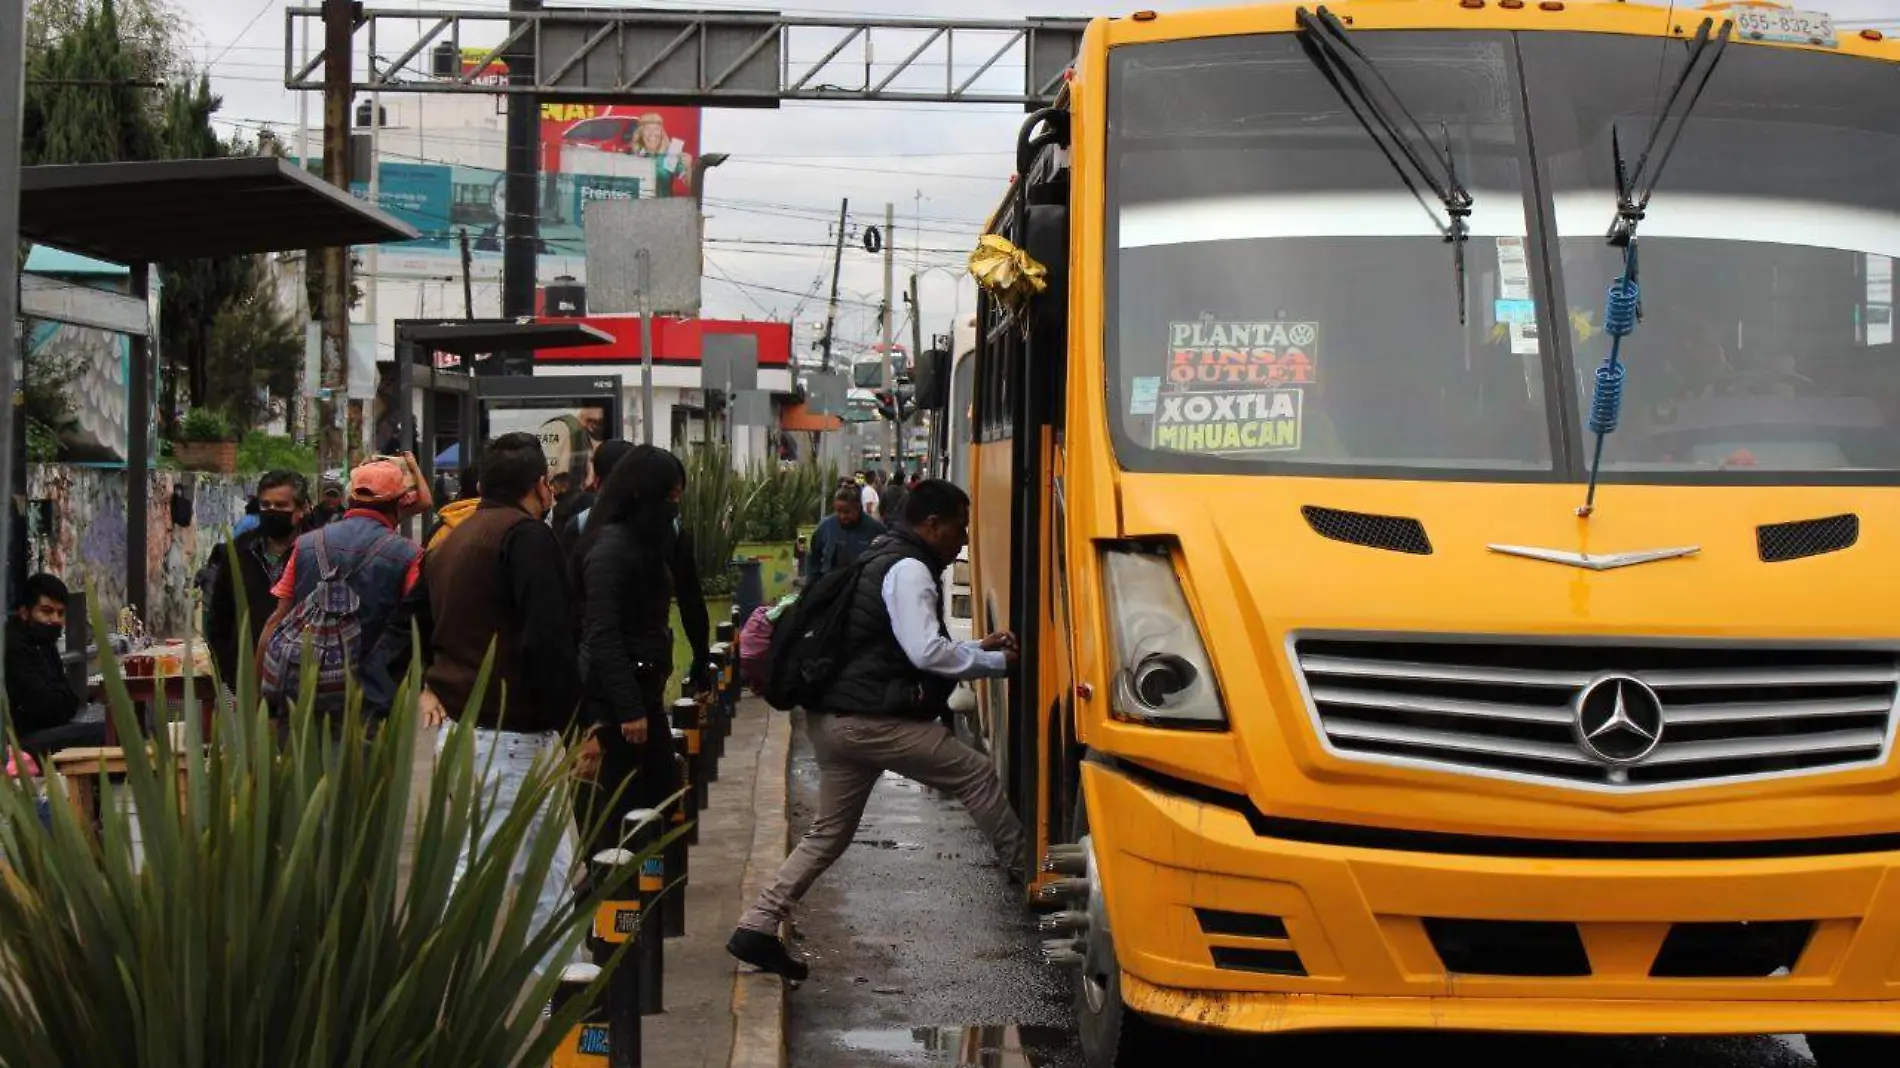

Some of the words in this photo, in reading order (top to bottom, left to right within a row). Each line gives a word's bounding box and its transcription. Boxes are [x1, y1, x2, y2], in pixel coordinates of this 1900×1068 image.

[1172, 324, 1290, 346] PLANTA
[1172, 347, 1312, 364] FINSA
[1170, 364, 1313, 383] OUTLET
[1160, 393, 1295, 423] XOXTLA
[1158, 420, 1295, 451] MIHUACAN
